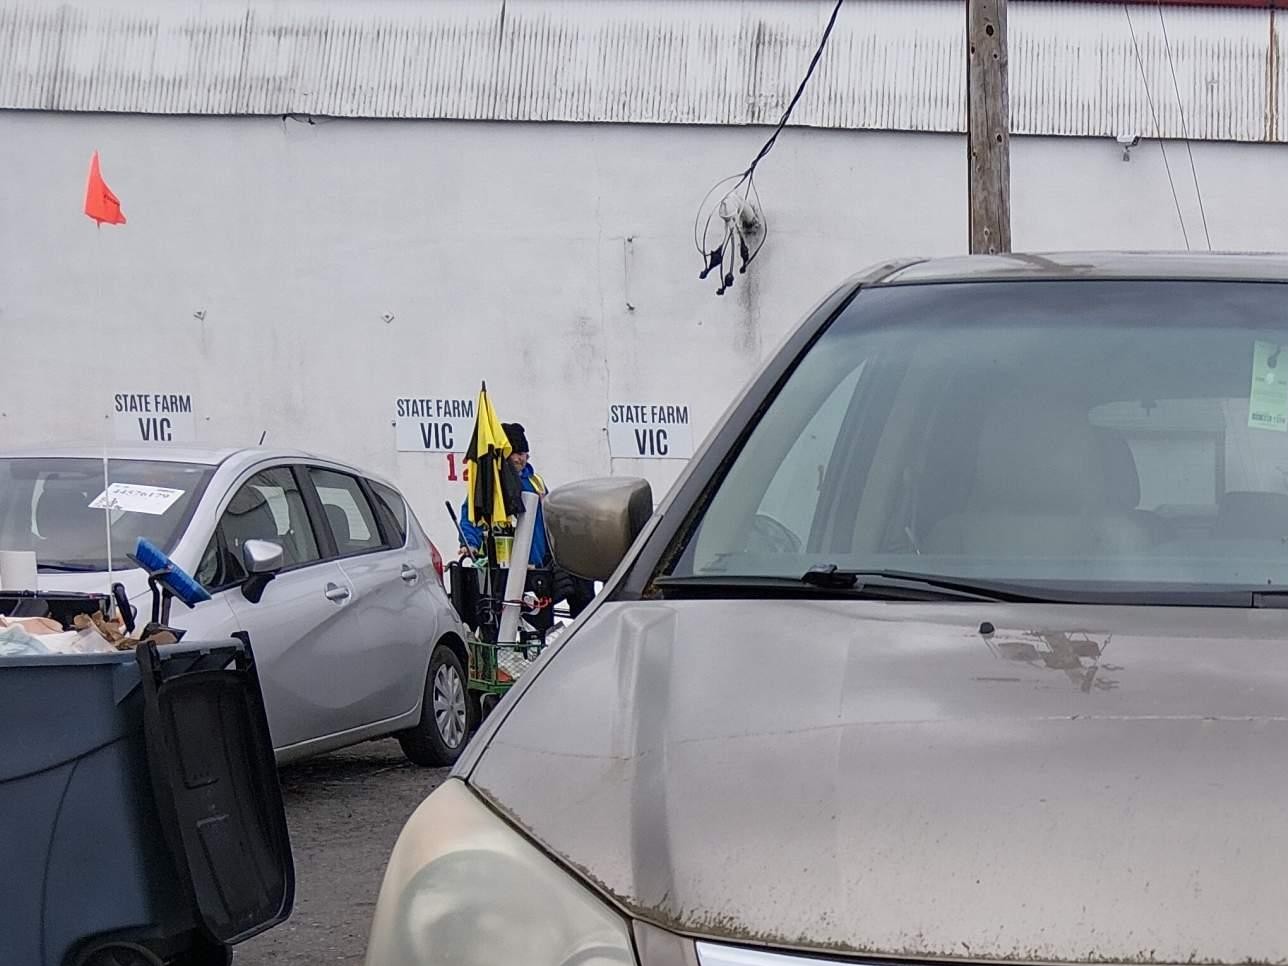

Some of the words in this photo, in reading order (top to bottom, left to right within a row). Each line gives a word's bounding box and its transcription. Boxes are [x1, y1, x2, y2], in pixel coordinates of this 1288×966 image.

[115, 394, 151, 412] STATE
[154, 394, 192, 413] FARM
[396, 398, 433, 417] STATE
[436, 399, 474, 418] FARM
[610, 405, 648, 423] STATE
[651, 405, 689, 424] FARM
[138, 417, 172, 441] VIC
[420, 422, 454, 449] VIC
[634, 428, 668, 456] VIC
